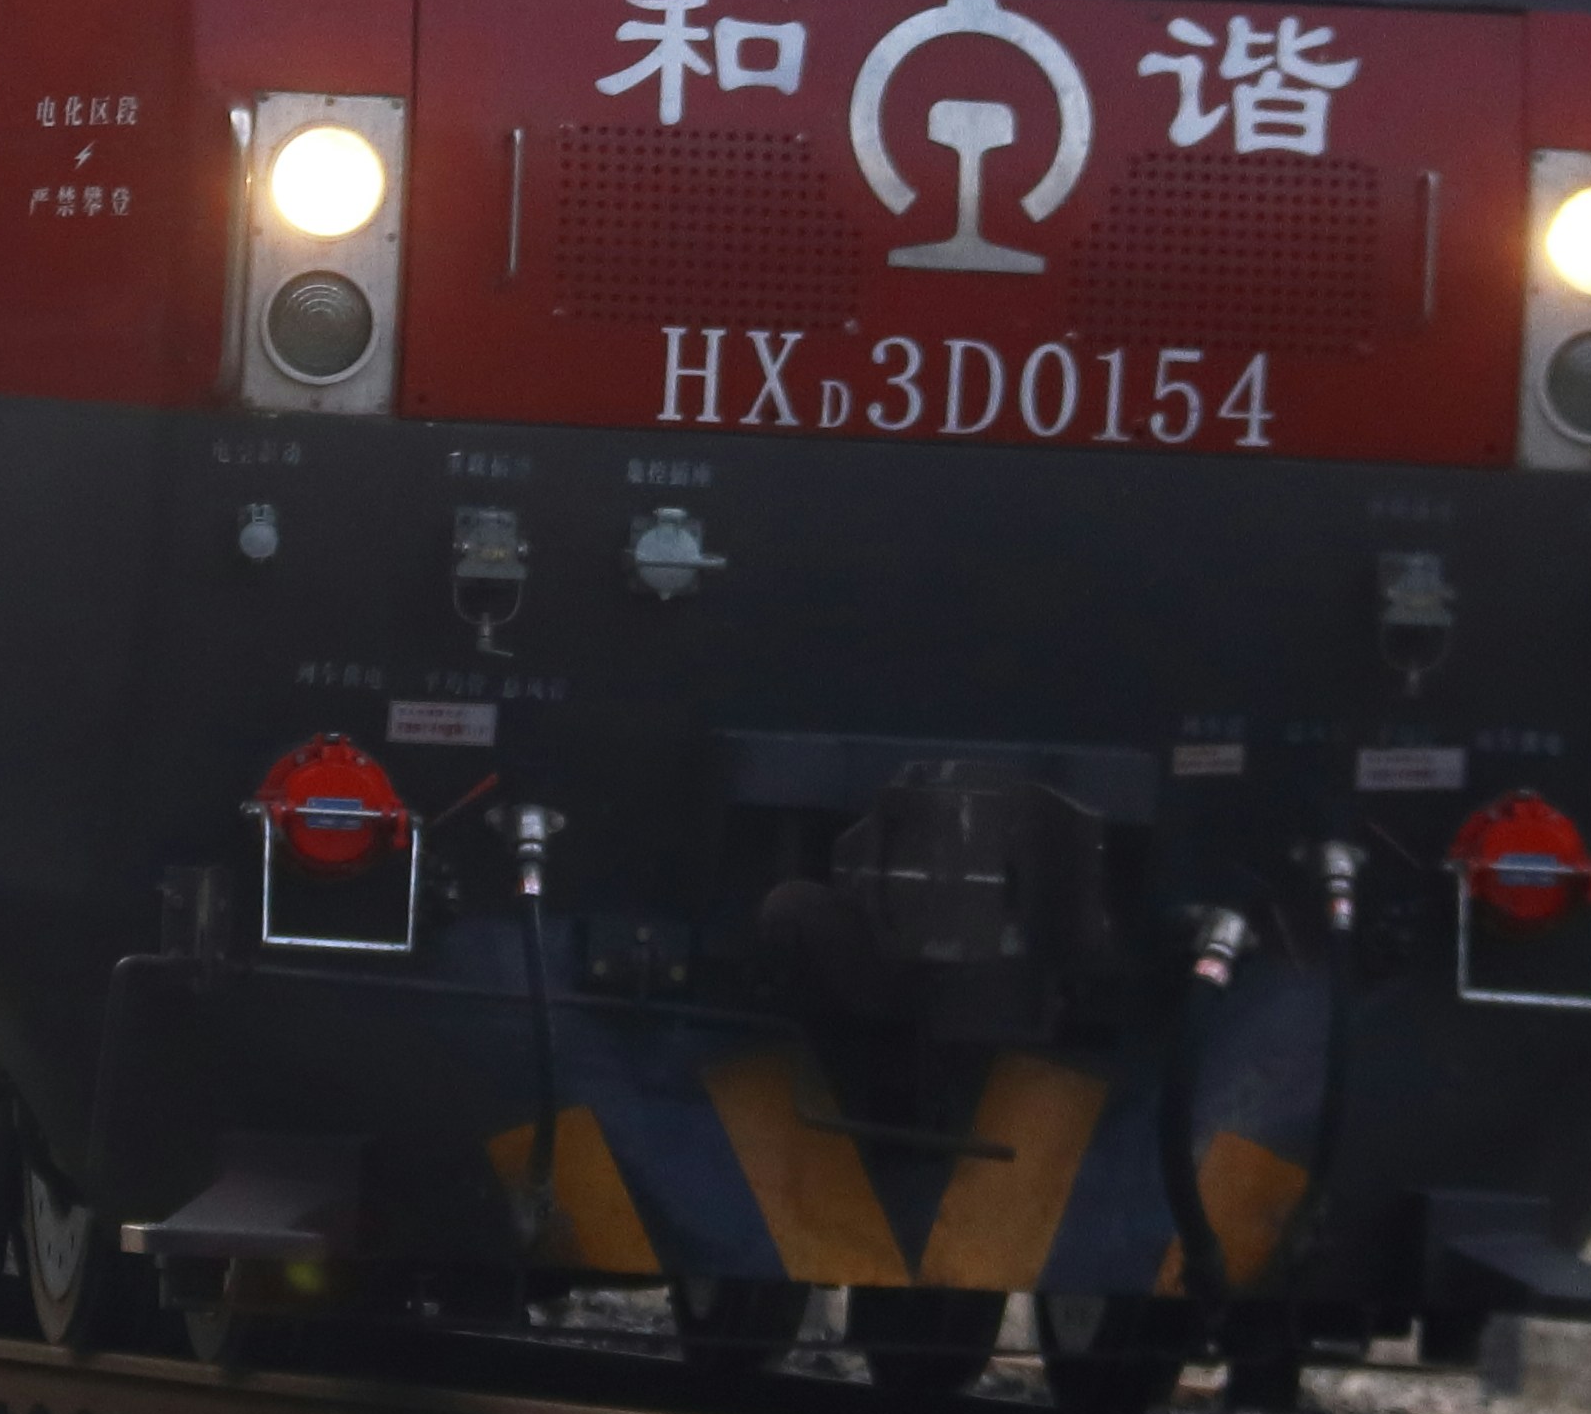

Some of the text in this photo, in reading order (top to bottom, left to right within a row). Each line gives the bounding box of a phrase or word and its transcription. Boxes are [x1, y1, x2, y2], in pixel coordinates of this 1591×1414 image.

[36, 95, 140, 128] 电化区段
[1137, 15, 1359, 157] 谐
[28, 185, 133, 218] 严禁攀登
[658, 326, 1273, 446] HXD3D0154
